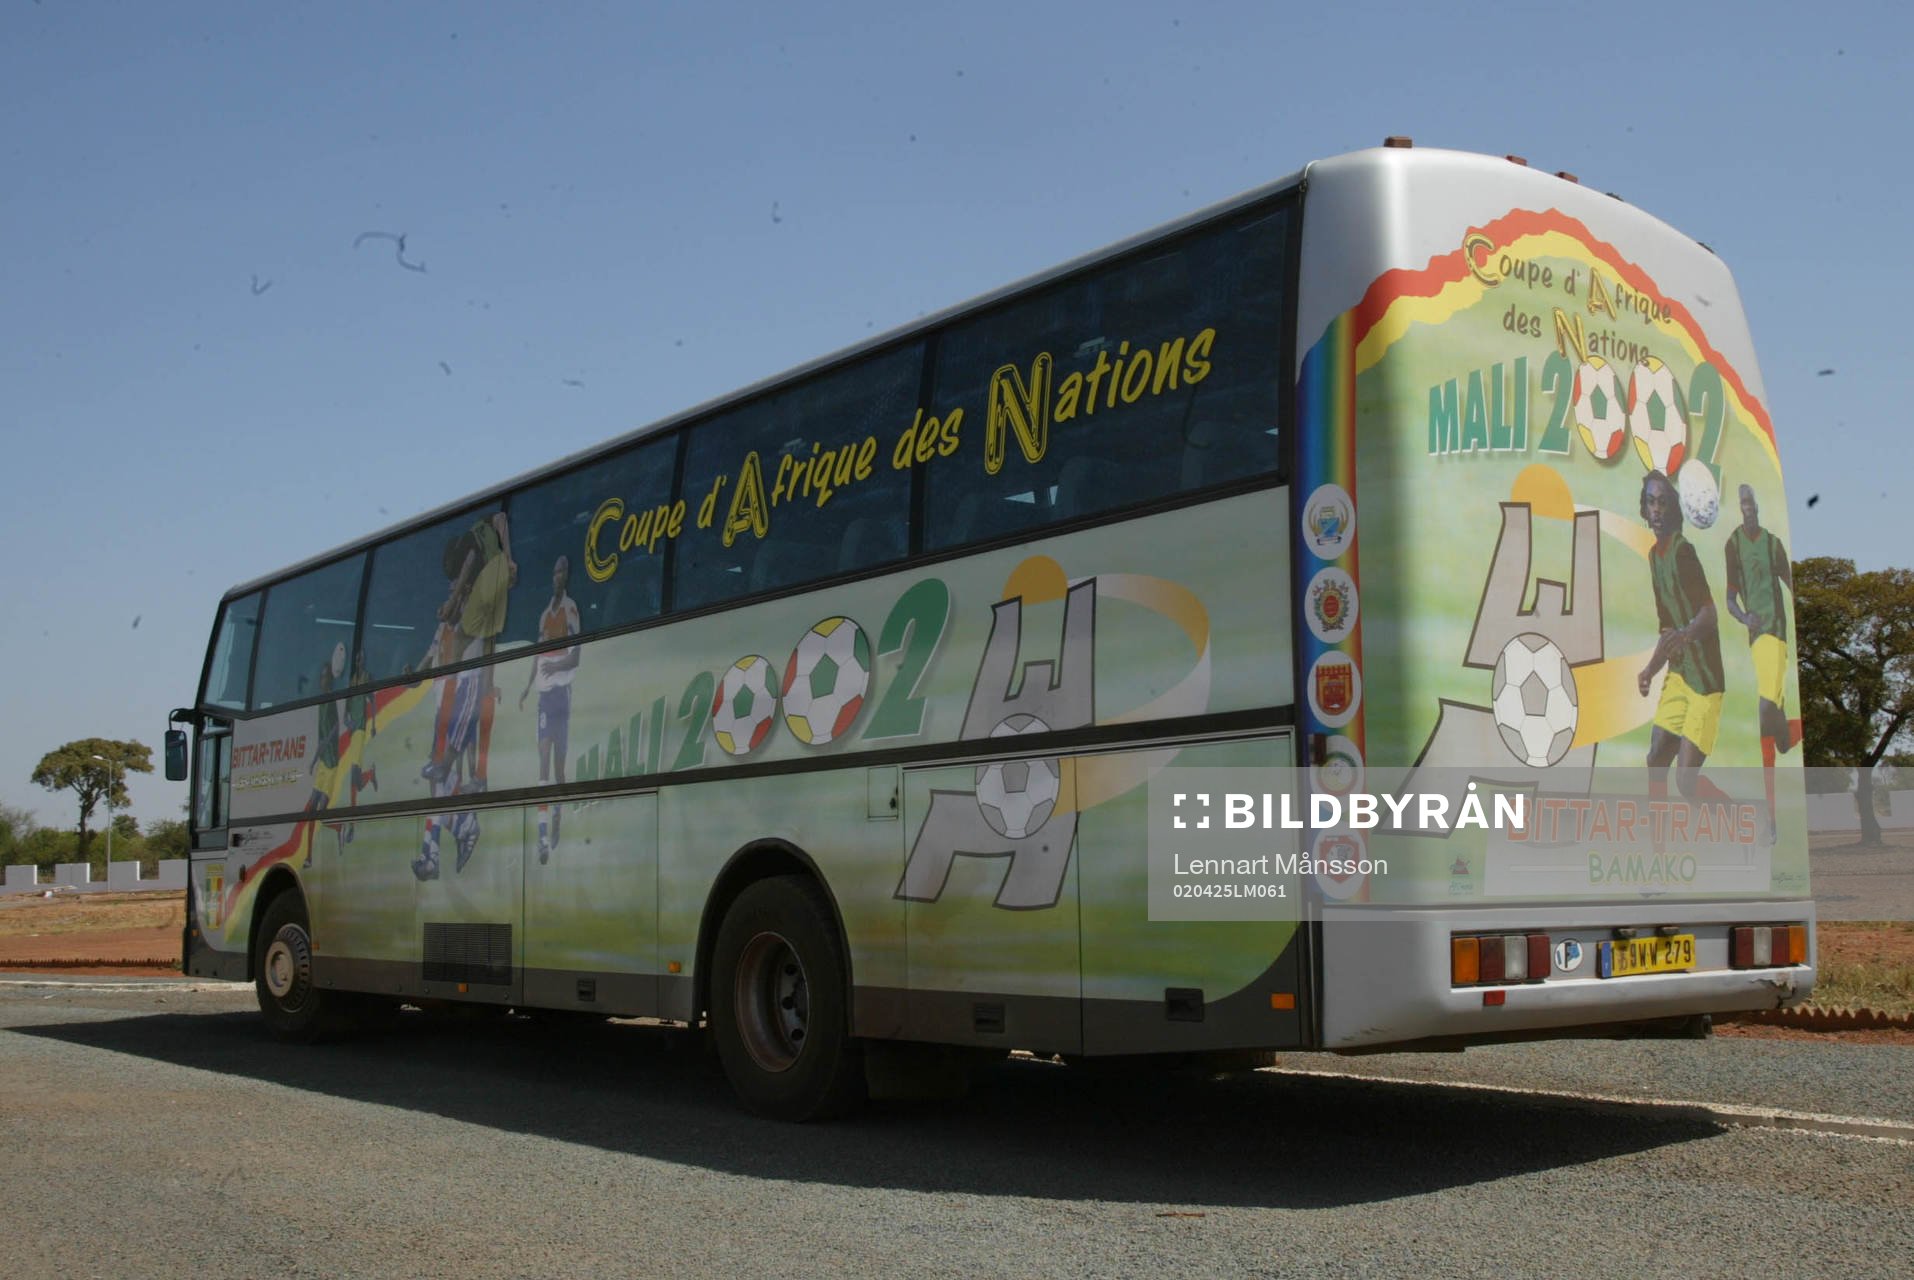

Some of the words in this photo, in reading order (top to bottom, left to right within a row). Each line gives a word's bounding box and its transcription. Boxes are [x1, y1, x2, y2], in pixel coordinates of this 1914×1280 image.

[1464, 233, 1552, 287] Coupe
[1502, 303, 1542, 338] des
[1552, 307, 1650, 367] Nations
[1428, 356, 1528, 455] MALI
[585, 497, 686, 582] Coupe
[893, 407, 964, 470] des
[985, 328, 1216, 475] Nations
[1587, 850, 1698, 885] BAMAKO
